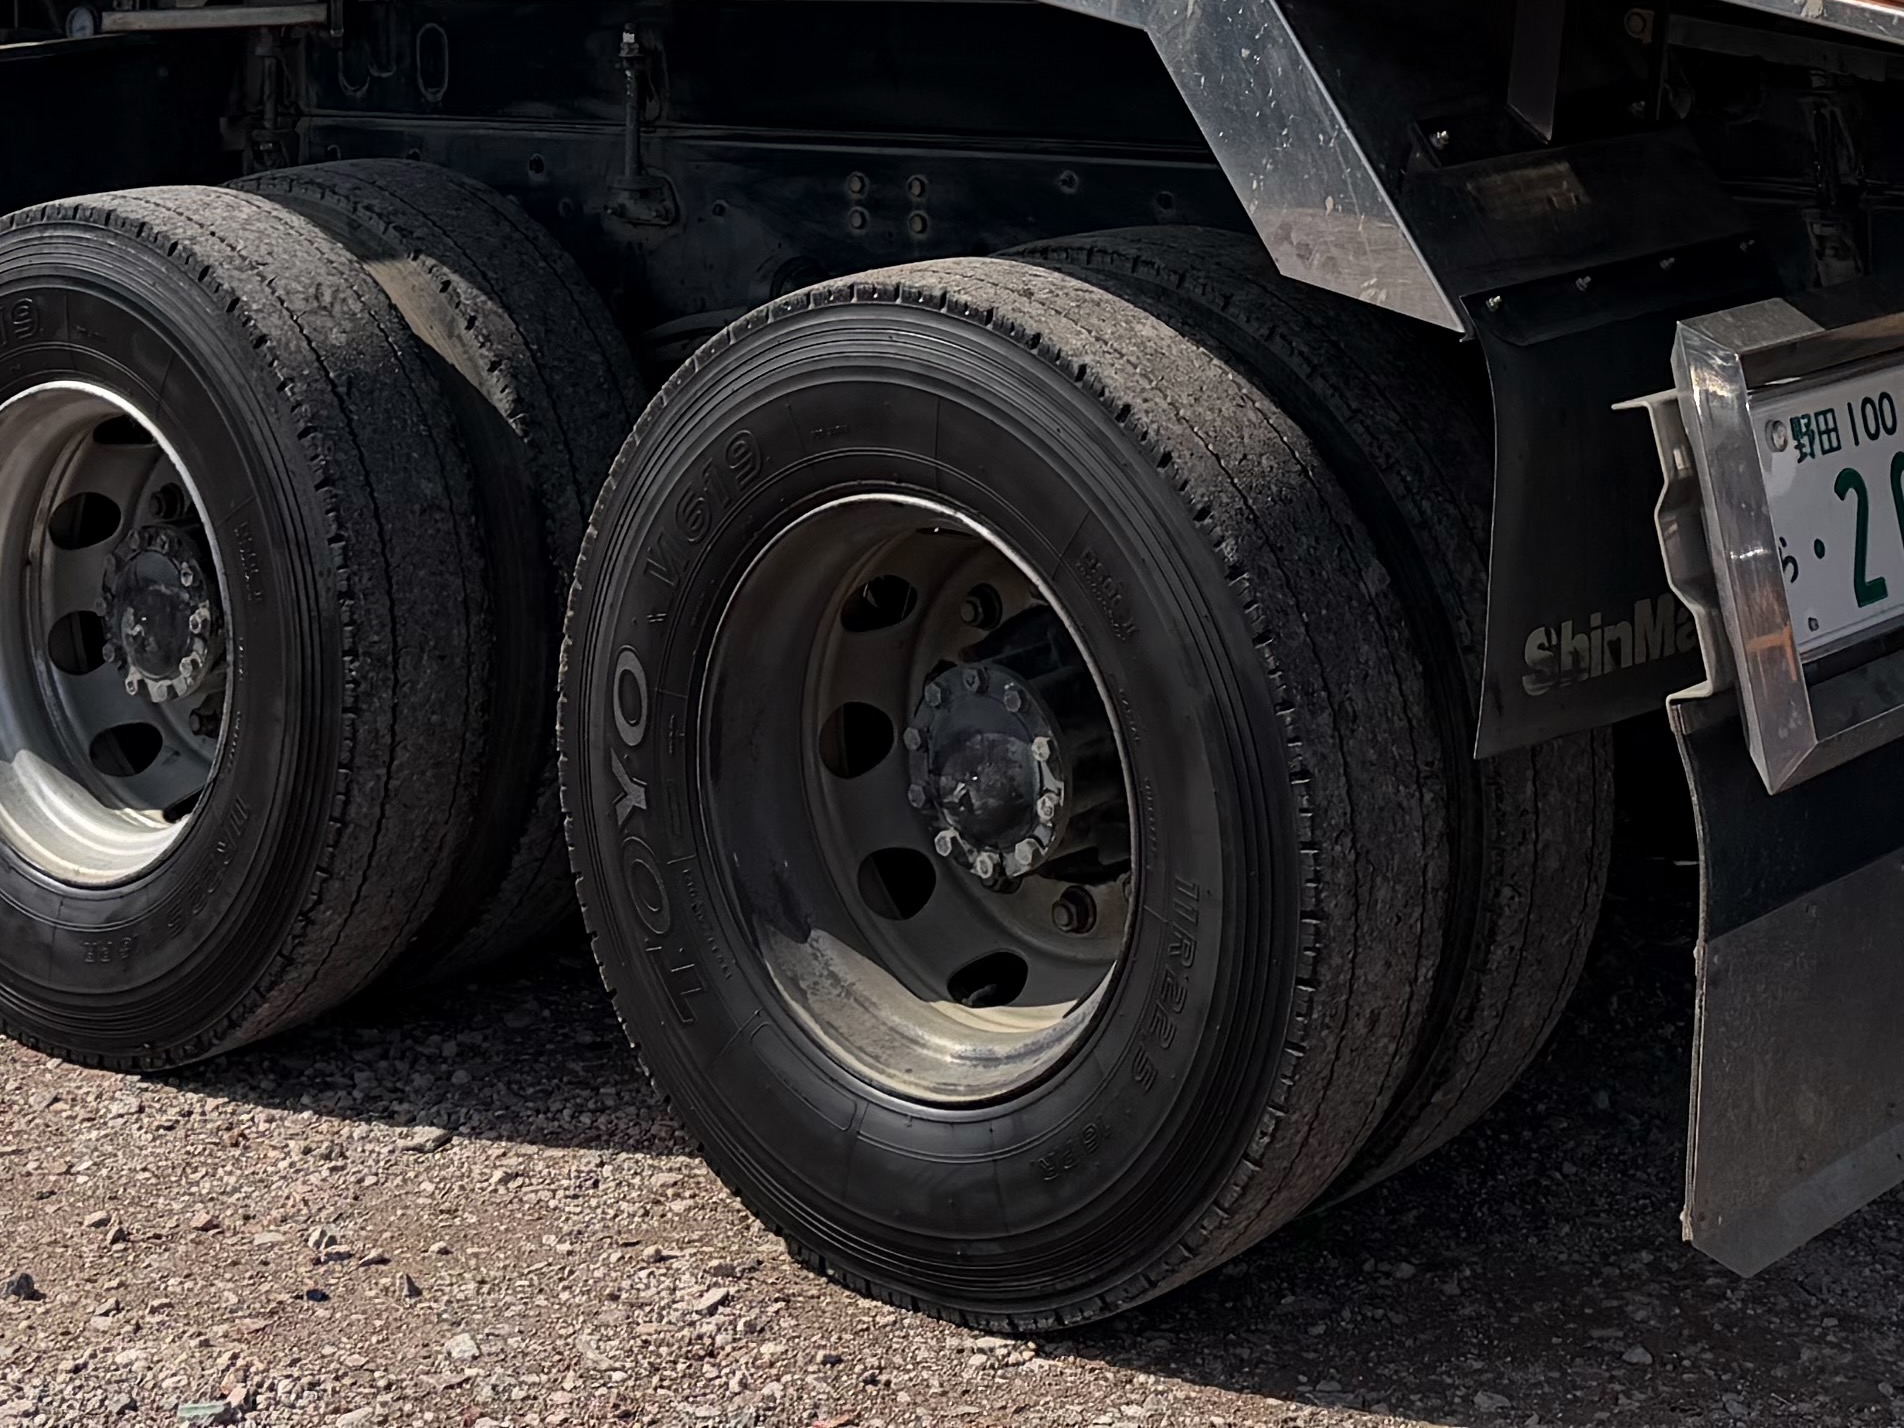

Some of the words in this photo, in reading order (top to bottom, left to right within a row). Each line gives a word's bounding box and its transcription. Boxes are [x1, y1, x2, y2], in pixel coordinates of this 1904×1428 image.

[1789, 407, 1842, 463] 野田
[1847, 391, 1897, 446] 100
[610, 645, 708, 1024] TOYO
